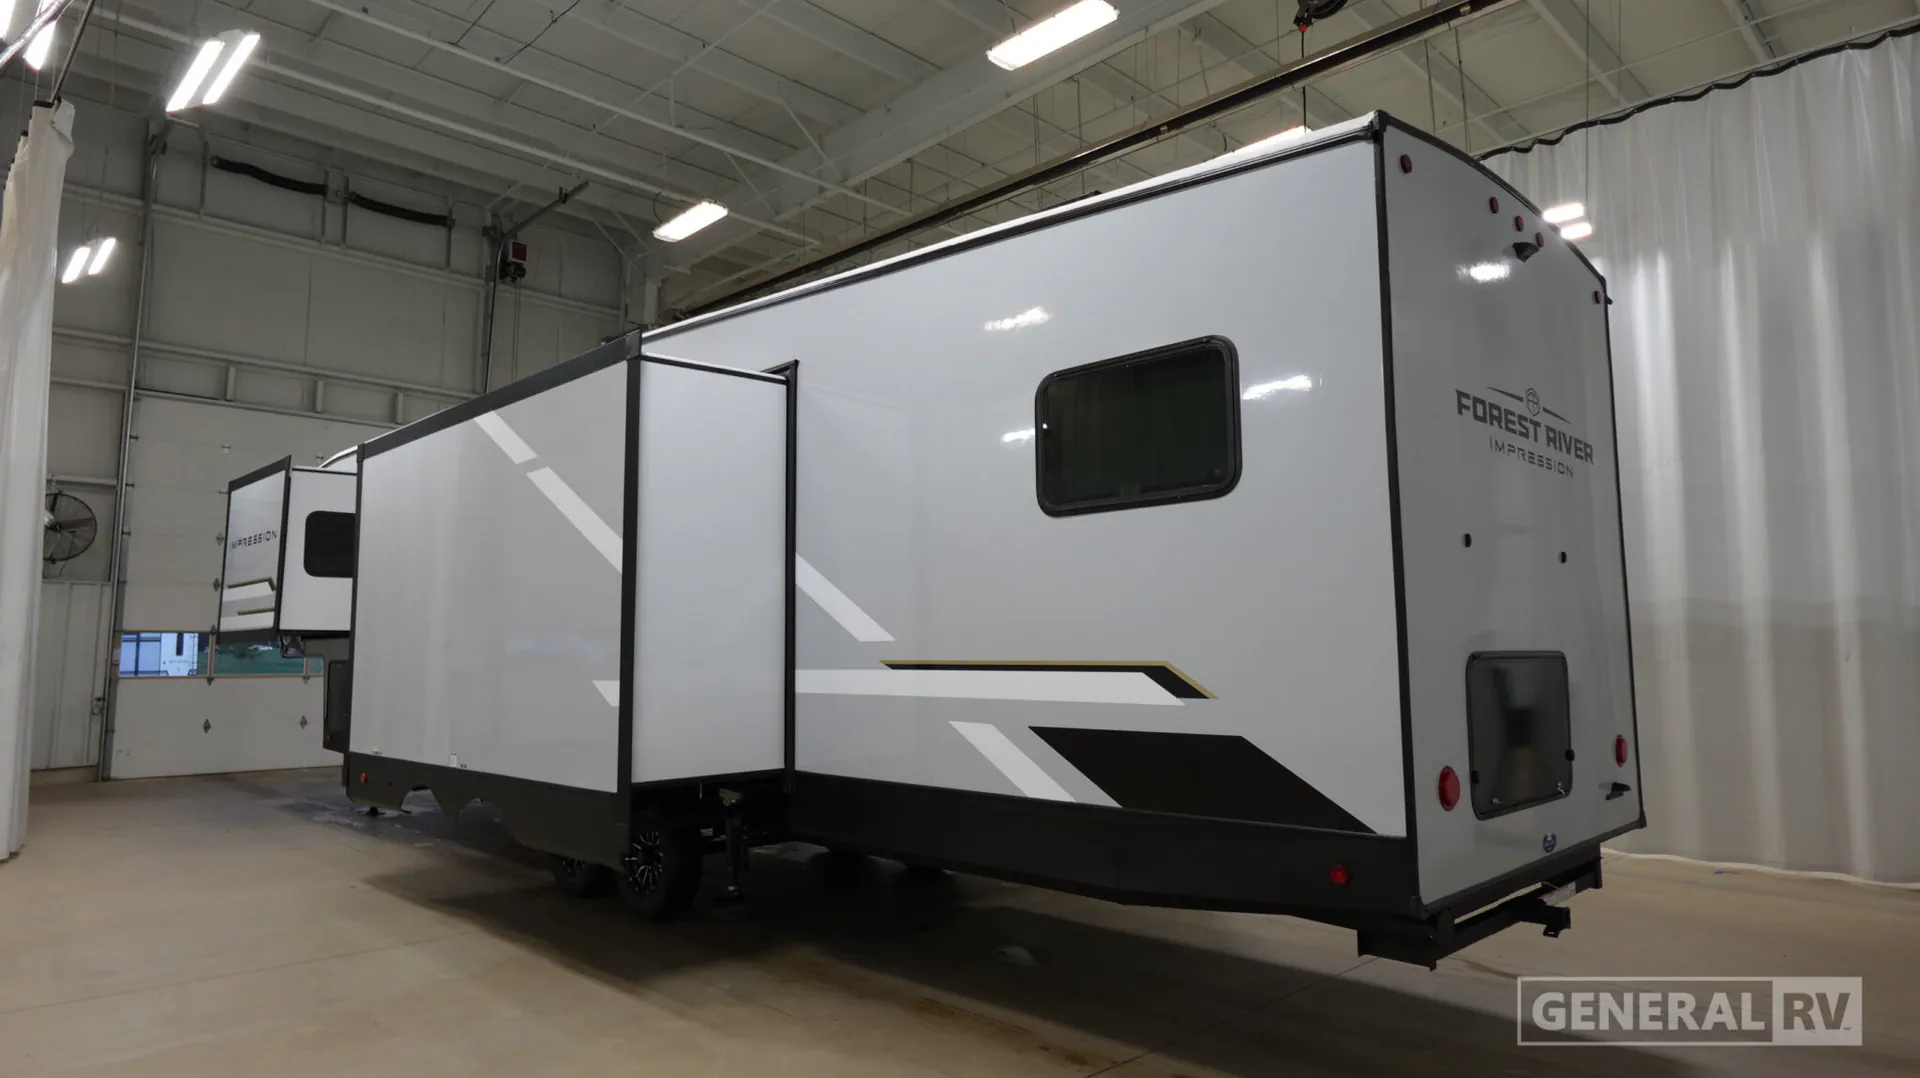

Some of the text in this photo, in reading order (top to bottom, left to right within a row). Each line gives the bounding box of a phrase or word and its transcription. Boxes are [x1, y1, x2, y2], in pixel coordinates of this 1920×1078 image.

[1455, 389, 1594, 465] FOREST RIVER
[1489, 436, 1573, 478] IMPRESSION
